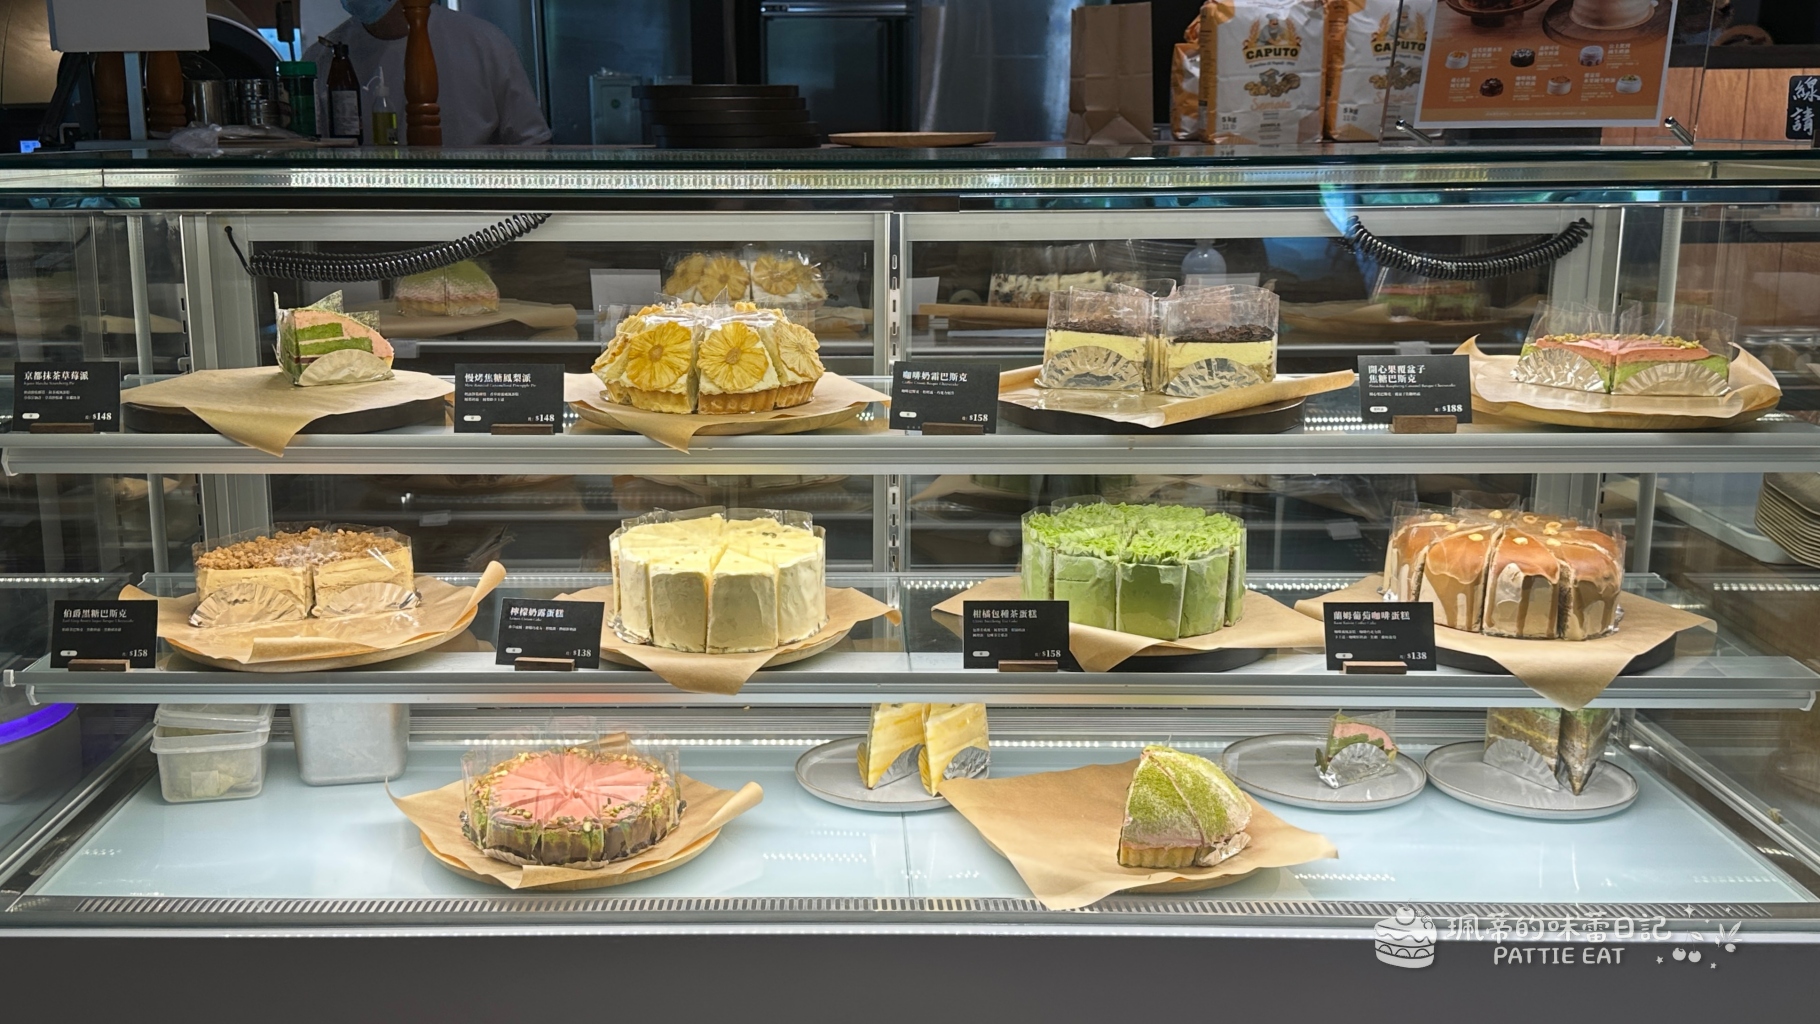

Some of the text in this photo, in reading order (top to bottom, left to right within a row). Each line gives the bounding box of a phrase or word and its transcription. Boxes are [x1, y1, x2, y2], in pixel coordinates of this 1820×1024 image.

[1246, 47, 1299, 60] CAPUTO
[1227, 116, 1238, 124] kg
[1790, 106, 1815, 136] 請
[1368, 364, 1426, 374] 開心果覆盆子
[24, 371, 89, 381] 京都抹茶草莓派
[464, 373, 531, 383] 慢烤焦糖鳳梨派
[1368, 374, 1417, 384] 焦糖巴斯克
[1442, 404, 1463, 412] $188
[92, 412, 112, 420] $148
[969, 413, 989, 422] $158
[63, 608, 127, 618] 伯爵黑糖巴斯克
[510, 606, 565, 618] 檸檬奶露蛋糕
[972, 609, 1038, 619] 柑橘包種茶蛋糕
[1333, 610, 1411, 621] 蘭姆葡萄咖啡蛋糕
[129, 649, 148, 657] $158
[572, 648, 592, 657] $138
[1041, 649, 1061, 658] $158
[1406, 651, 1428, 660] $138
